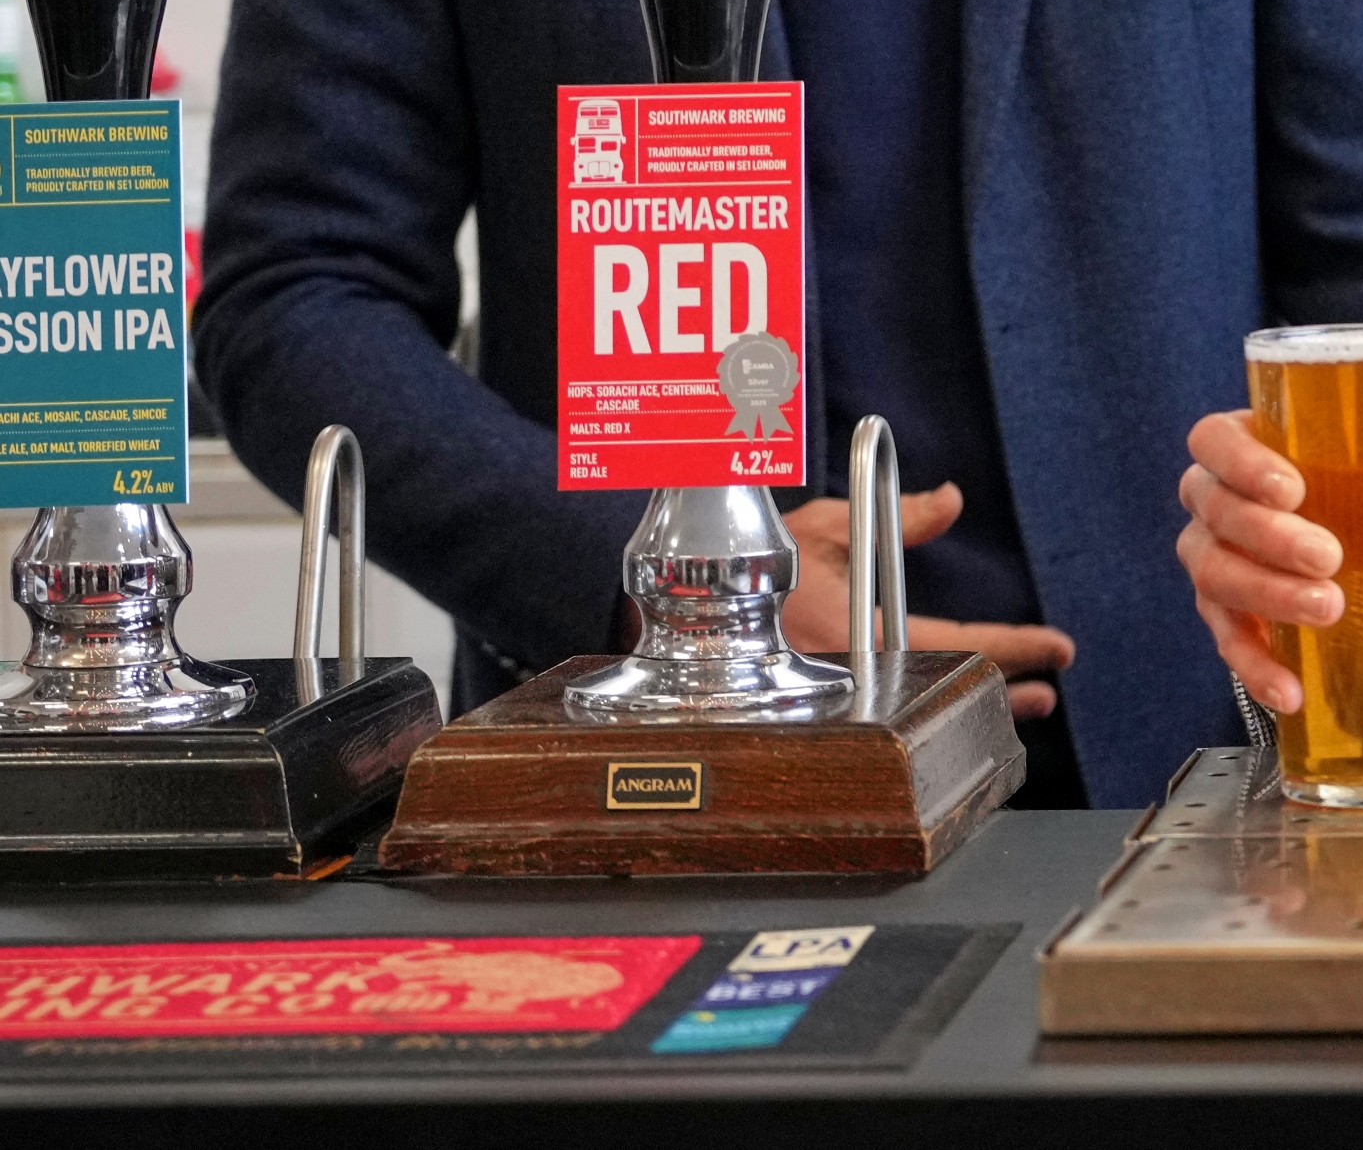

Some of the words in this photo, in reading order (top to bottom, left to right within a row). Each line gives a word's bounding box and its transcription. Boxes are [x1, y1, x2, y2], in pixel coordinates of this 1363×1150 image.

[648, 109, 727, 126] SOUTHWARK
[729, 108, 786, 124] BREWING
[25, 126, 106, 145] SOUTHWARK
[109, 125, 168, 143] BREWING
[647, 146, 711, 159] TRADITIONALLY
[712, 145, 749, 157] BREWED
[750, 144, 773, 157] BEER,
[25, 167, 91, 179] TRADITIONALLY
[92, 166, 129, 178] BREWED
[130, 165, 156, 178] BEER,
[647, 161, 686, 173] PROUDLY
[687, 160, 725, 172] CRAFTED
[726, 160, 736, 171] IN
[737, 160, 751, 171] SE1
[752, 159, 787, 171] LONDON
[26, 181, 64, 193] PROUDLY
[66, 180, 104, 192] CRAFTED
[105, 179, 115, 191] IN
[117, 179, 133, 191] SE1
[134, 178, 169, 191] LONDON
[570, 195, 789, 234] ROUTEMASTER
[0, 252, 174, 298] YFLOWER
[593, 242, 768, 355] RED
[114, 308, 175, 351] IPA
[568, 385, 595, 399] HOPS.
[597, 385, 638, 398] SORACHI
[639, 385, 661, 399] ACE,
[661, 383, 720, 397] CENTENNIAL,
[596, 399, 640, 412] CASCADE
[22, 411, 43, 425] ACE,
[44, 410, 83, 423] MOSAIC,
[84, 408, 131, 422] CASCADE,
[132, 407, 167, 420] SIMCOE
[570, 423, 603, 436] MALTS.
[604, 422, 623, 435] RED
[624, 422, 631, 434] X
[9, 442, 29, 456] ALE,
[30, 442, 49, 454] OAT
[50, 440, 77, 455] MALT,
[77, 439, 127, 453] TORREFIED
[128, 438, 161, 451] WHEAT
[570, 453, 598, 466] STYLE
[729, 449, 774, 475] 4.2%
[774, 462, 794, 475] ABV
[570, 467, 589, 479] RED
[590, 466, 608, 478] ALE
[113, 469, 154, 495] 4.2%
[155, 481, 175, 494] ABV
[616, 777, 693, 793] ANGRAM
[750, 937, 853, 959] LPA
[0, 971, 370, 997] HWARK
[705, 976, 830, 1001] BEST
[203, 992, 337, 1018] CO
